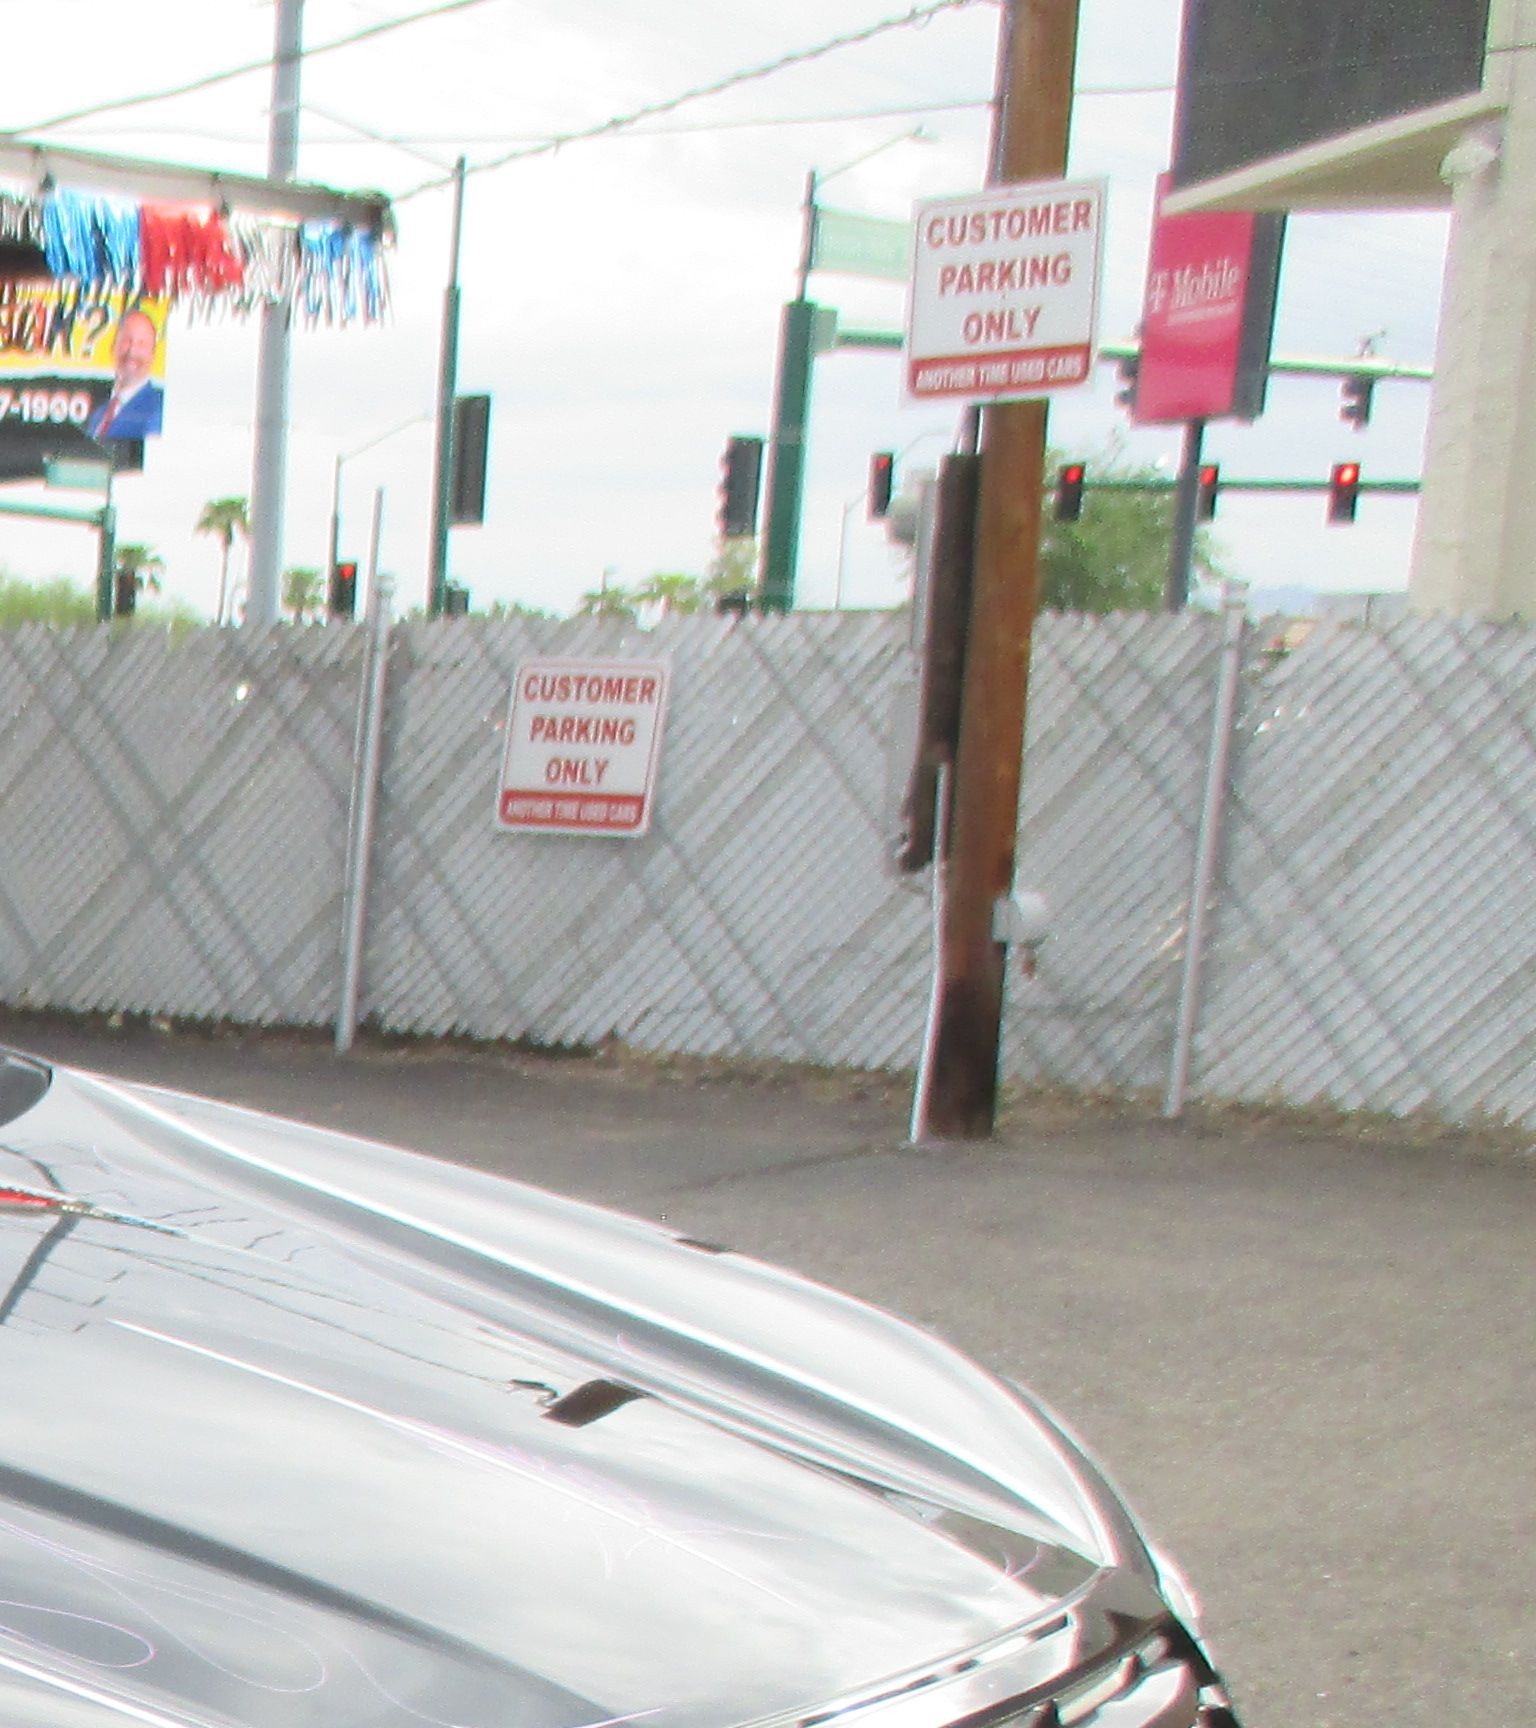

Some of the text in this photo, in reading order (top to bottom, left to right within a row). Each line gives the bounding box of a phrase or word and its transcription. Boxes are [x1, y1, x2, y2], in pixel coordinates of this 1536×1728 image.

[927, 200, 1092, 249] CUSTOMER
[939, 252, 1072, 297] PARKING
[962, 305, 1041, 344] ONLY
[524, 675, 656, 704] CUSTOMER
[529, 714, 636, 746] PARKING
[545, 757, 609, 785] ONLY
